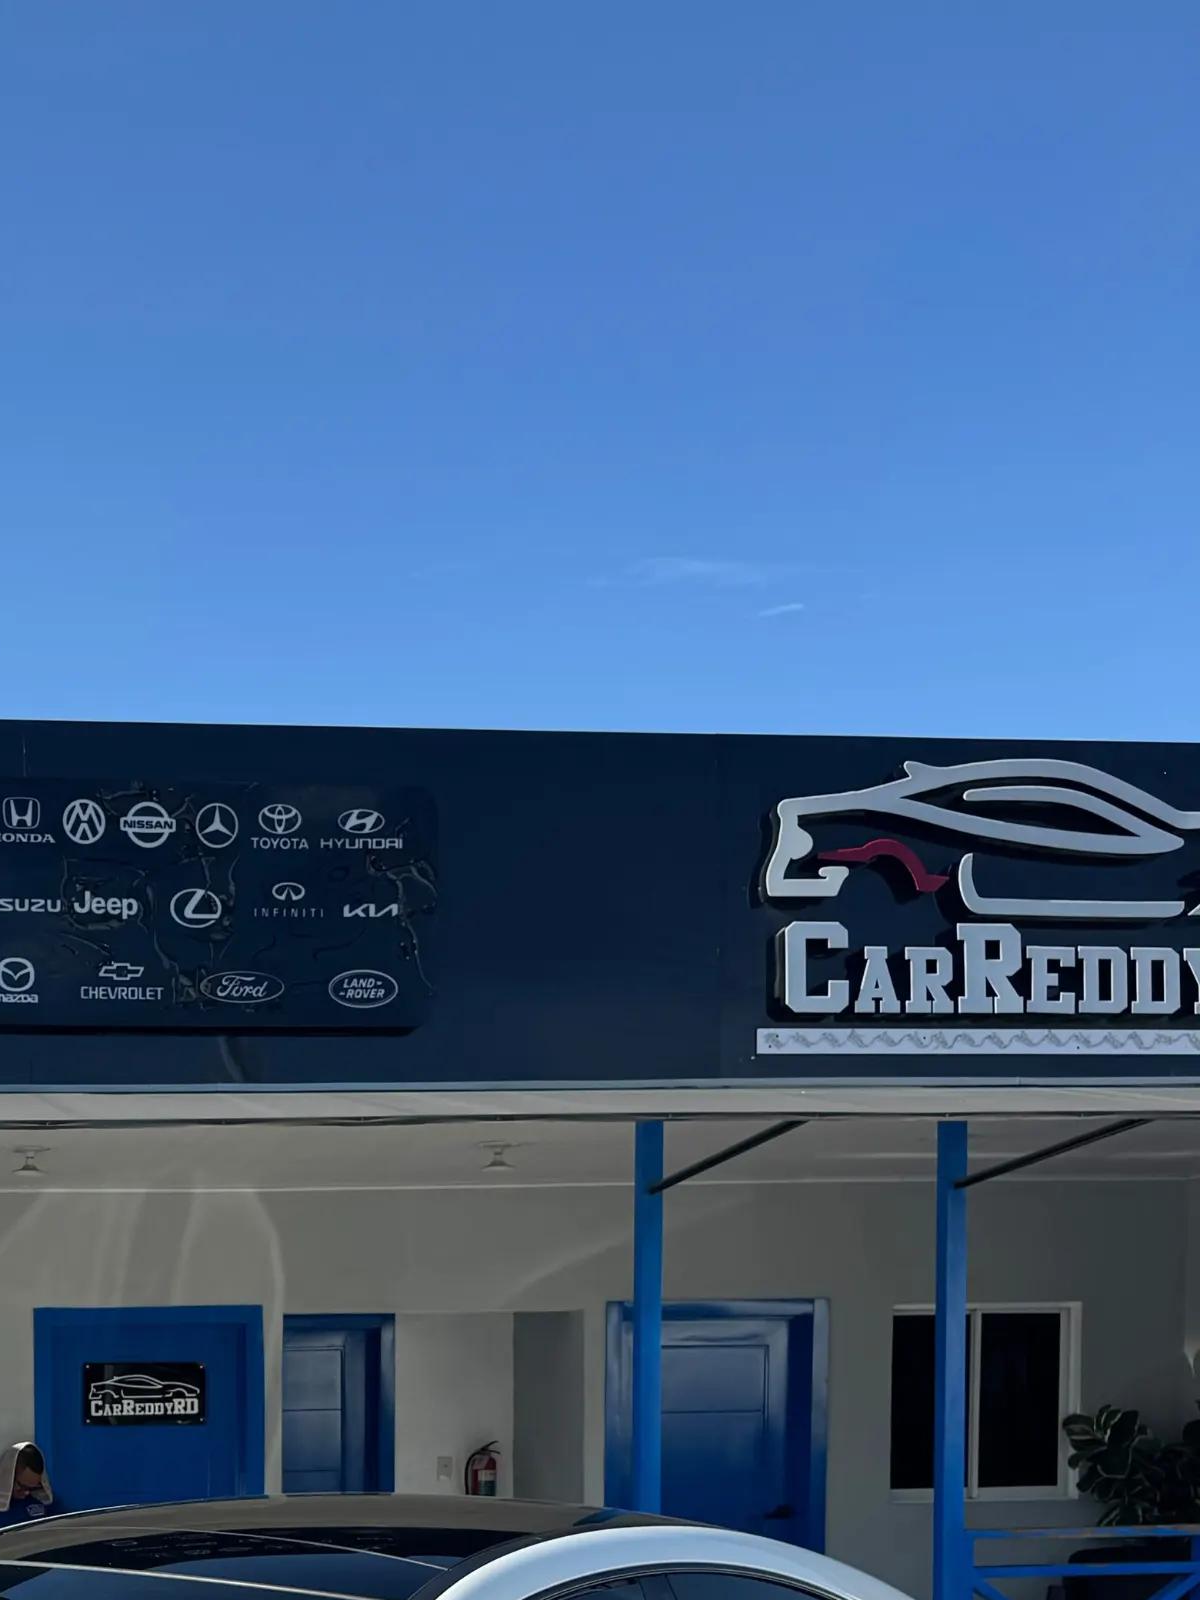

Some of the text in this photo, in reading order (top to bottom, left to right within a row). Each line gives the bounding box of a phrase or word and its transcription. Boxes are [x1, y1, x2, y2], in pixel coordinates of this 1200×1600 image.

[123, 820, 173, 830] NISSAN
[250, 837, 309, 850] TOYOTA
[320, 837, 403, 850] HYUNDAI
[72, 890, 138, 920] Jeep
[343, 903, 399, 918] KIA
[253, 907, 324, 918] INFINITI
[80, 986, 164, 1000] CHEVROLET
[216, 975, 268, 998] Ford
